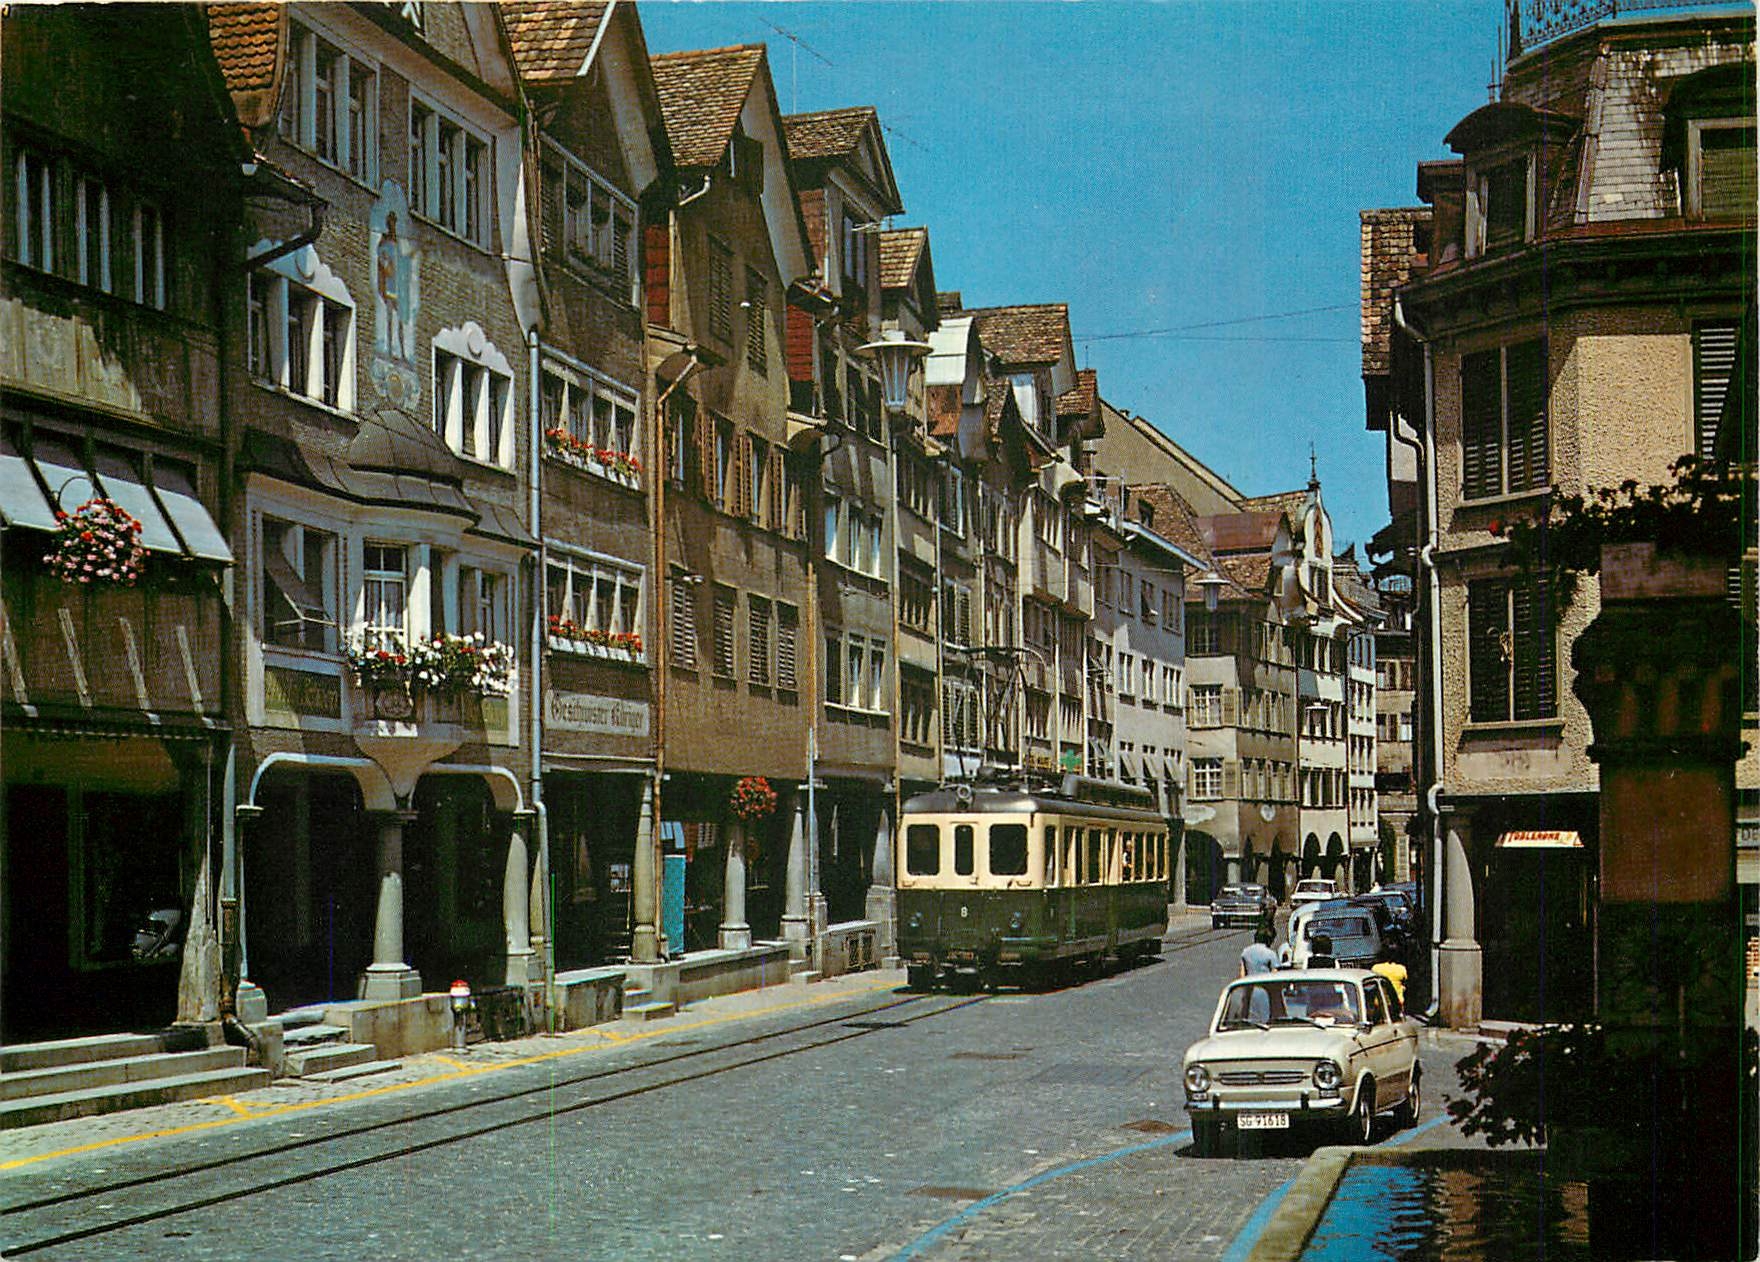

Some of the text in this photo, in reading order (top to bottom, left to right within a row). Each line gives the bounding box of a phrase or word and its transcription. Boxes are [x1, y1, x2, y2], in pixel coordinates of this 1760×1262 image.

[1508, 831, 1561, 842] TOBLERONE
[960, 906, 969, 918] 8
[1239, 1114, 1287, 1127] SG 91618
